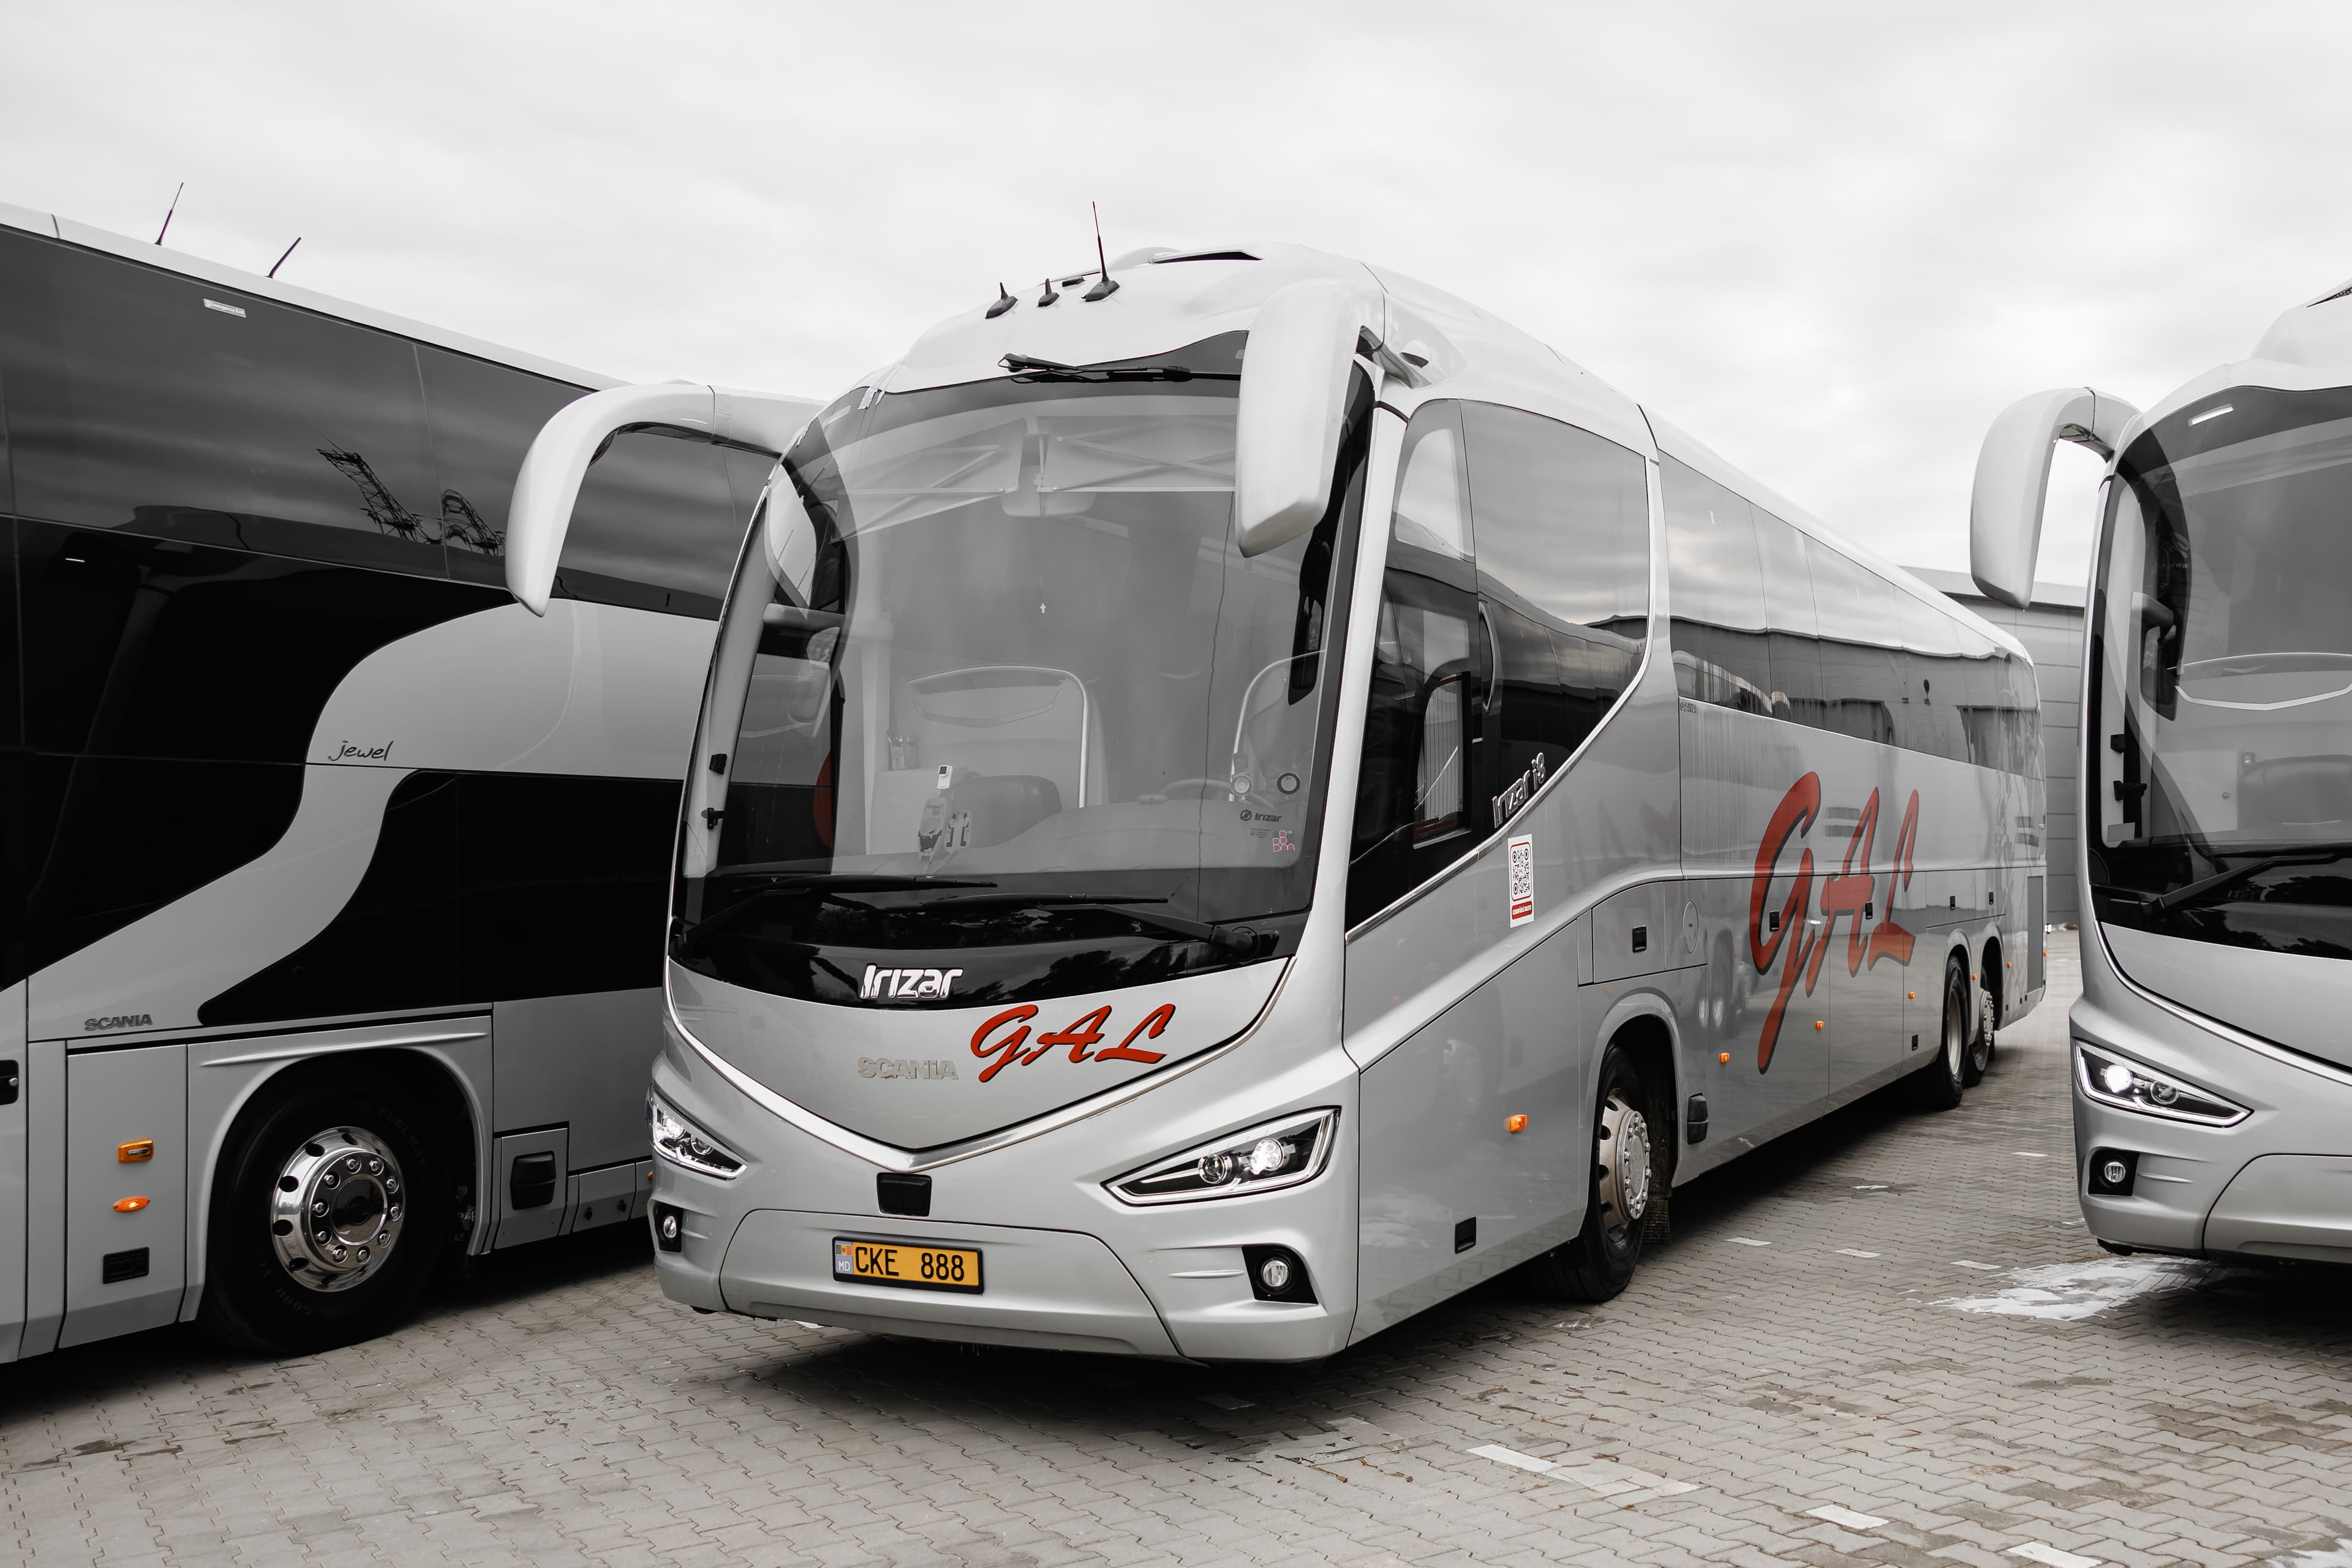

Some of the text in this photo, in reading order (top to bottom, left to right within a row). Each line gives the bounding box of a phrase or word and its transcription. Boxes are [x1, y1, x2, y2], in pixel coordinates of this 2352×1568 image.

[328, 740, 394, 761] jewel
[1493, 752, 1546, 828] Irizar i8
[1254, 813, 1282, 822] Irizar
[1749, 771, 1919, 1075] GAL
[860, 965, 963, 999] Irizar
[85, 1014, 153, 1031] SCANIA
[970, 1003, 1176, 1083] GAL
[858, 1057, 959, 1079] SCANIA
[838, 1261, 851, 1272] MD
[855, 1246, 965, 1281] CKE 888
